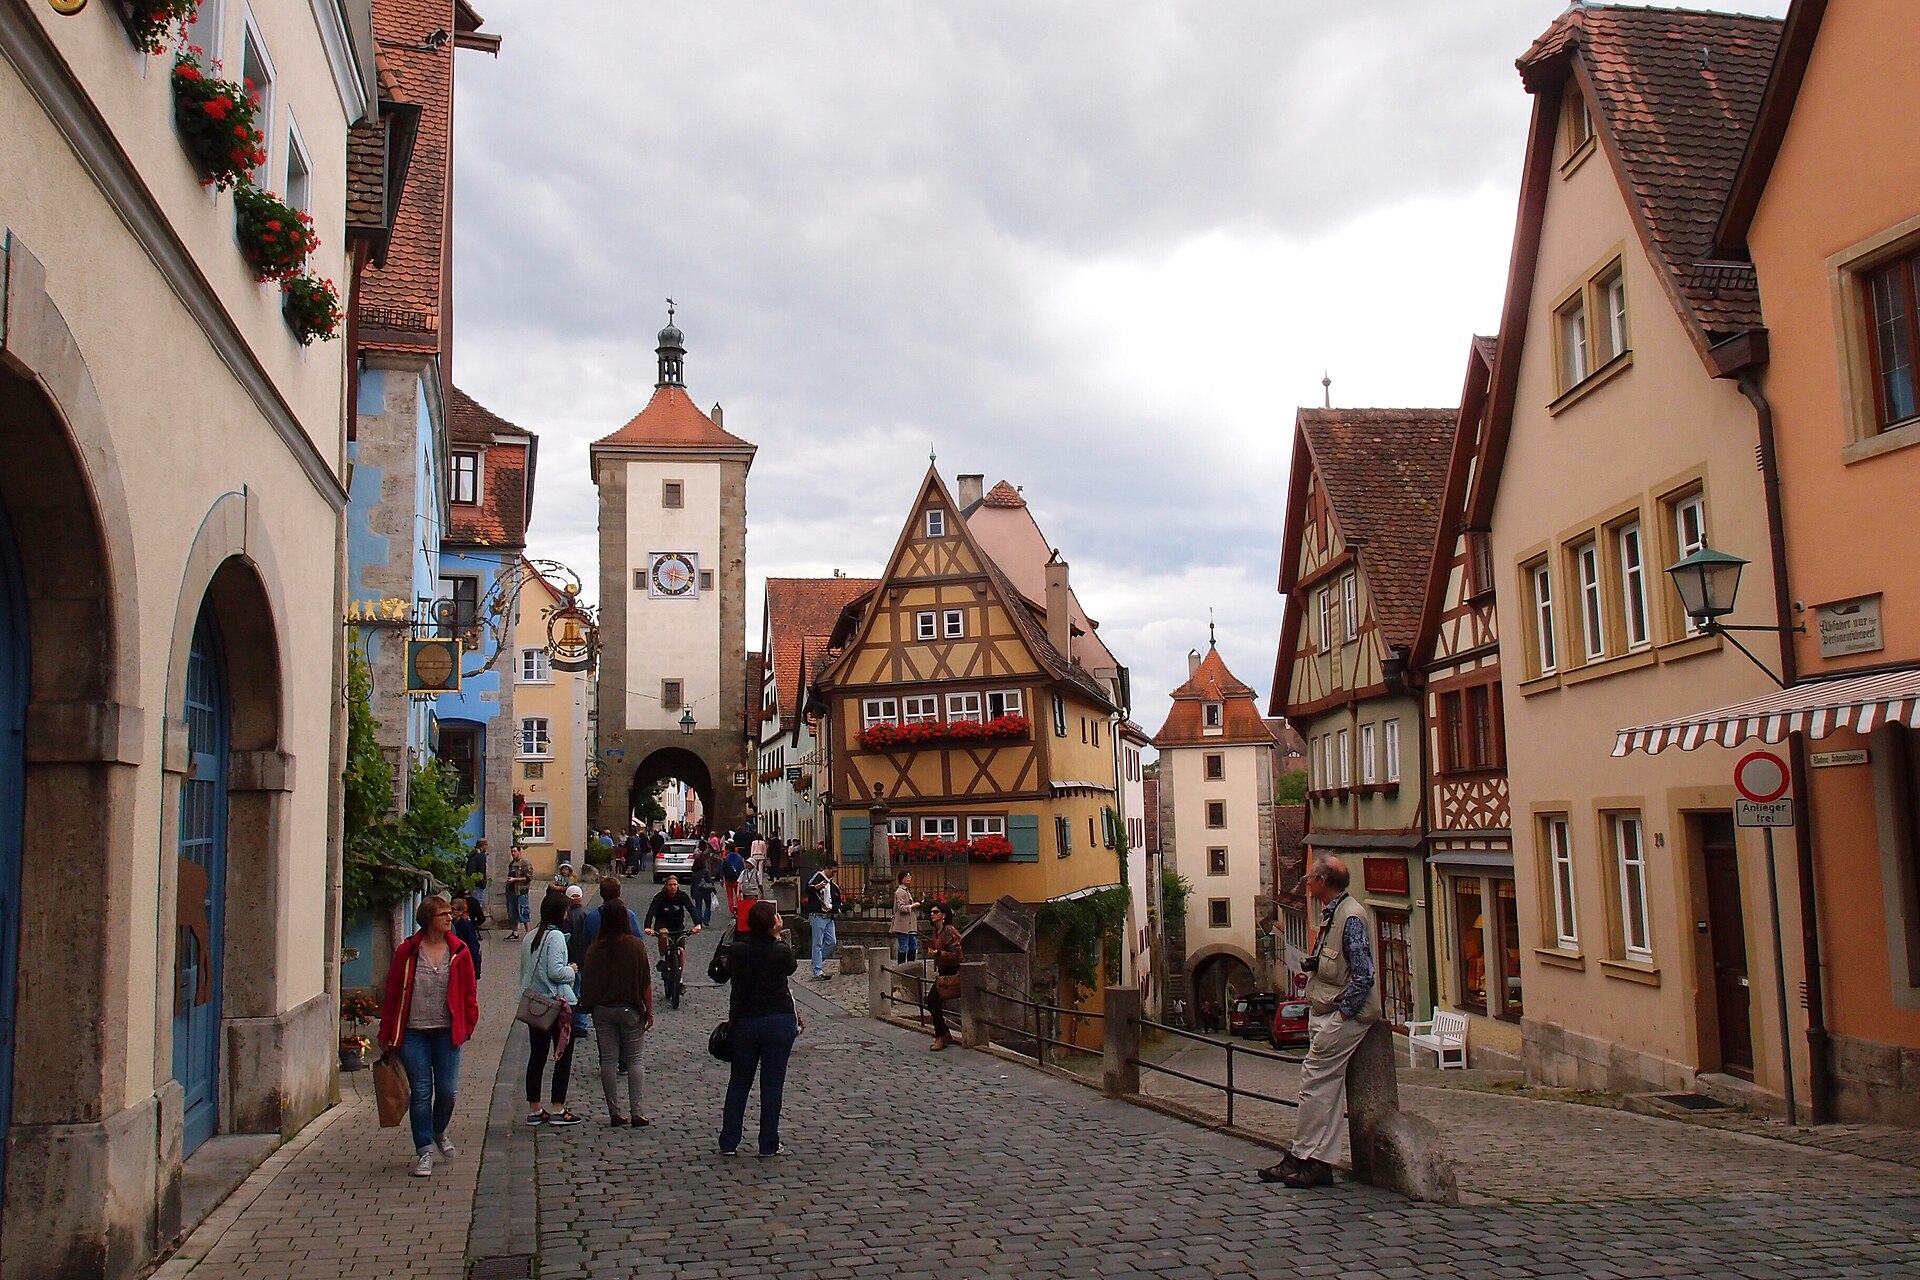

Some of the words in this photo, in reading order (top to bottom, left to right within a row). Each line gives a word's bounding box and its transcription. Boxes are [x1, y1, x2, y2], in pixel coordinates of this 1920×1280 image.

[1853, 618, 1867, 628] nur
[1743, 803, 1786, 813] Anlieger
[1756, 813, 1774, 823] frei
